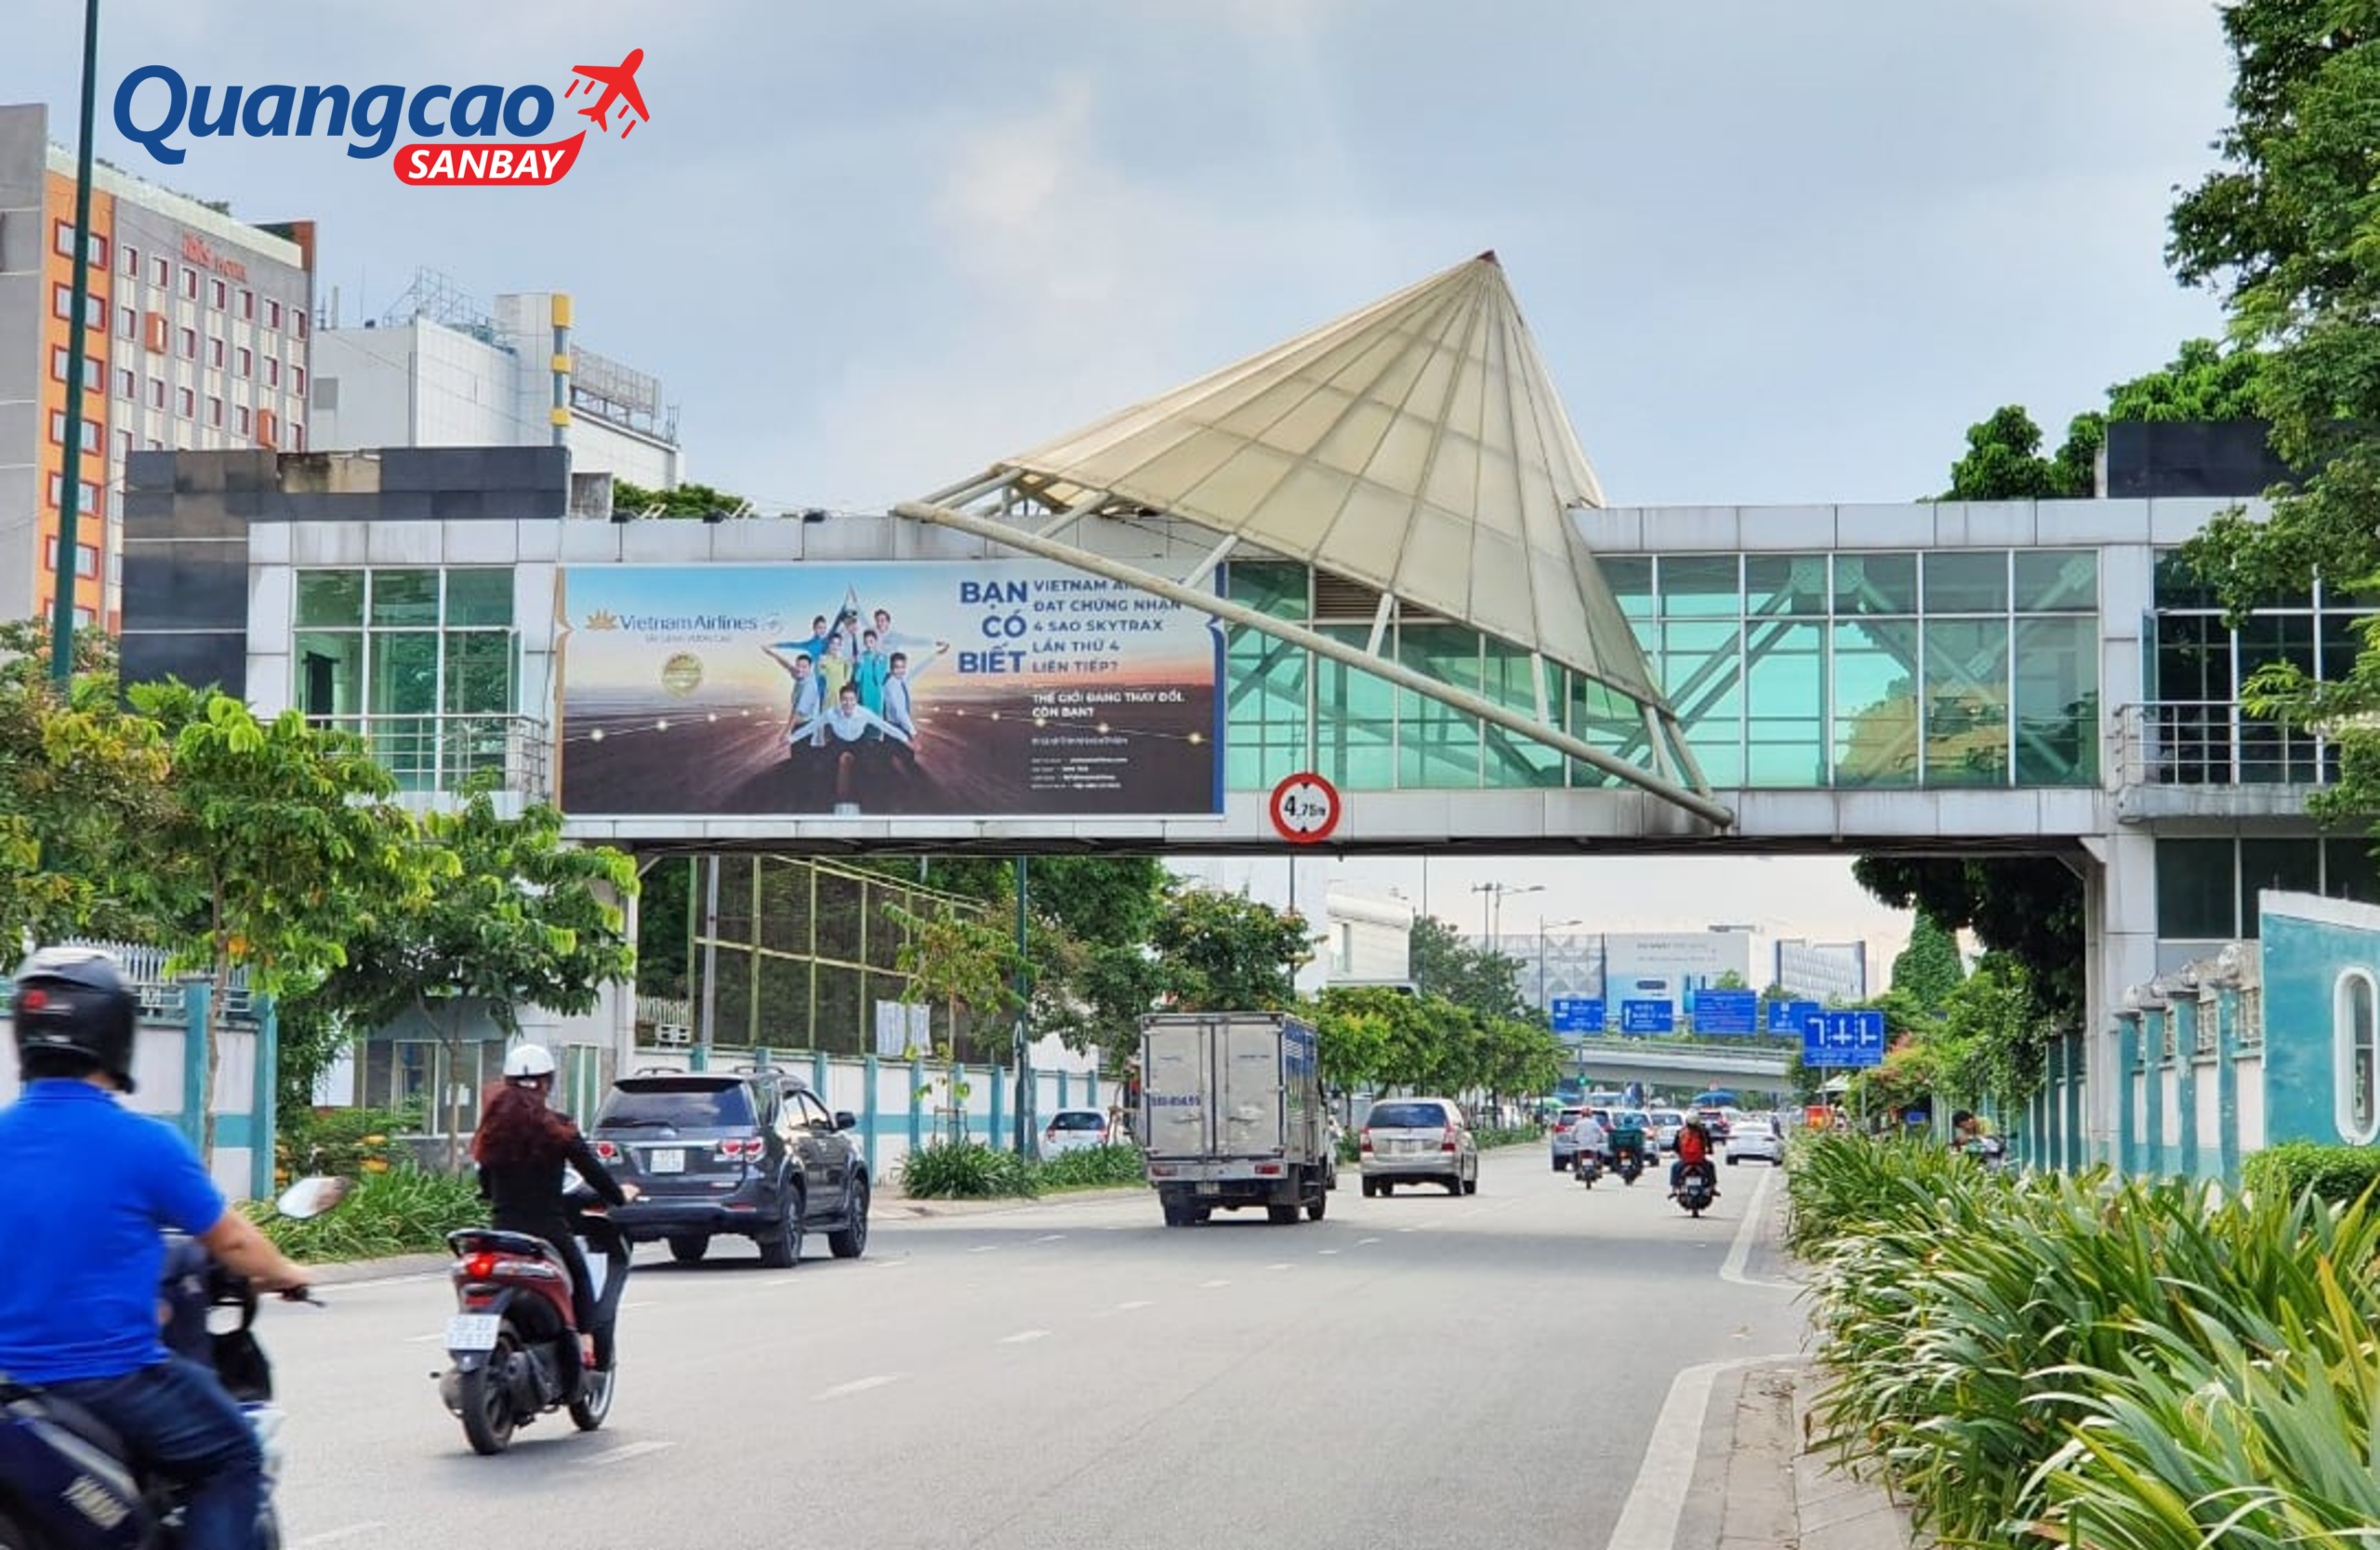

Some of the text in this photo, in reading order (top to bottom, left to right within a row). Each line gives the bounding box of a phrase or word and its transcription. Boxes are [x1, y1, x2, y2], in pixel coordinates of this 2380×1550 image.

[960, 580, 1028, 610] BẠN
[1034, 579, 1107, 592] VIETNAM
[982, 609, 1027, 639] CÓ
[1033, 618, 1164, 632] 4 SAO SKYTRAX
[1109, 639, 1121, 652] 4
[958, 642, 1026, 674] BIẾT
